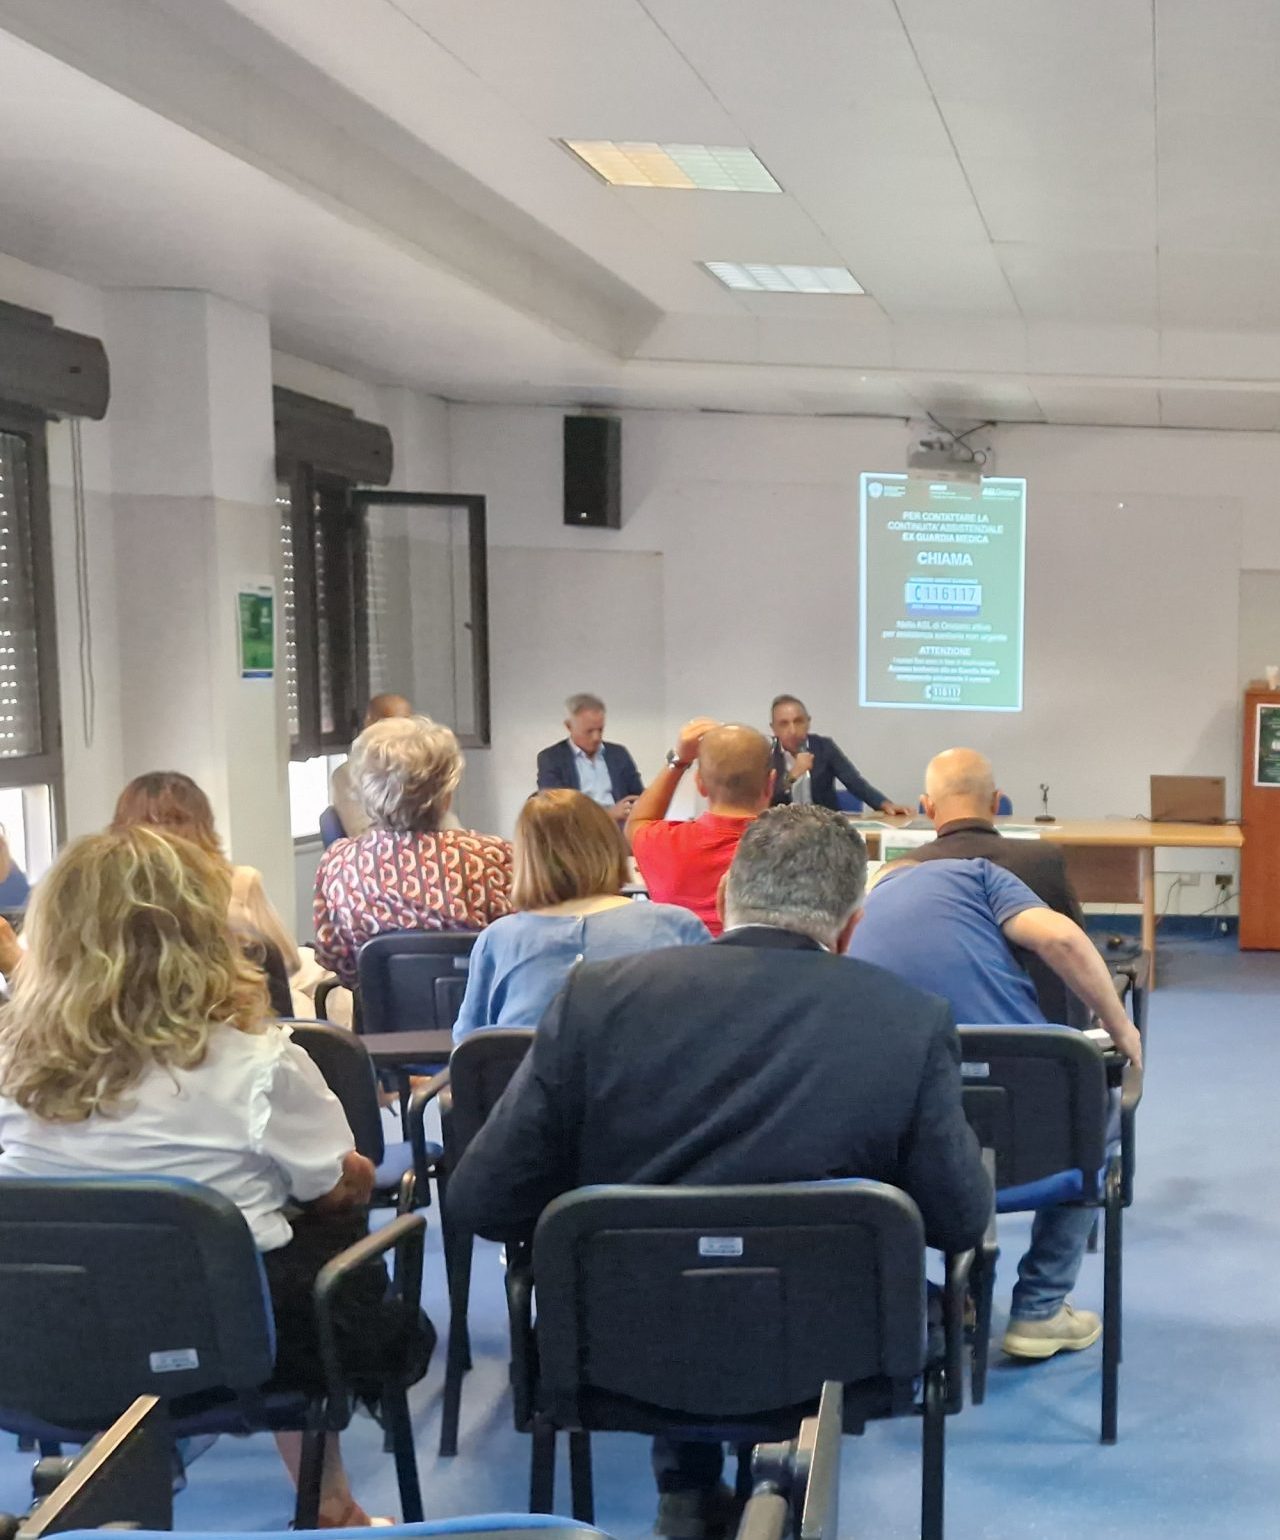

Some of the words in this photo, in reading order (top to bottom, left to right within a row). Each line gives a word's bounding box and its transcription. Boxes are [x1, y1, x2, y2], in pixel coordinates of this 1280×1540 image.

[902, 511, 921, 521] PER
[922, 512, 977, 523] CONTATTARE
[977, 513, 990, 523] LA
[902, 532, 916, 542] EX
[916, 533, 955, 543] GUARDIA
[955, 534, 990, 544] MEDICA
[917, 551, 974, 567] CHIAMA
[918, 645, 972, 656] ATTENZIONE
